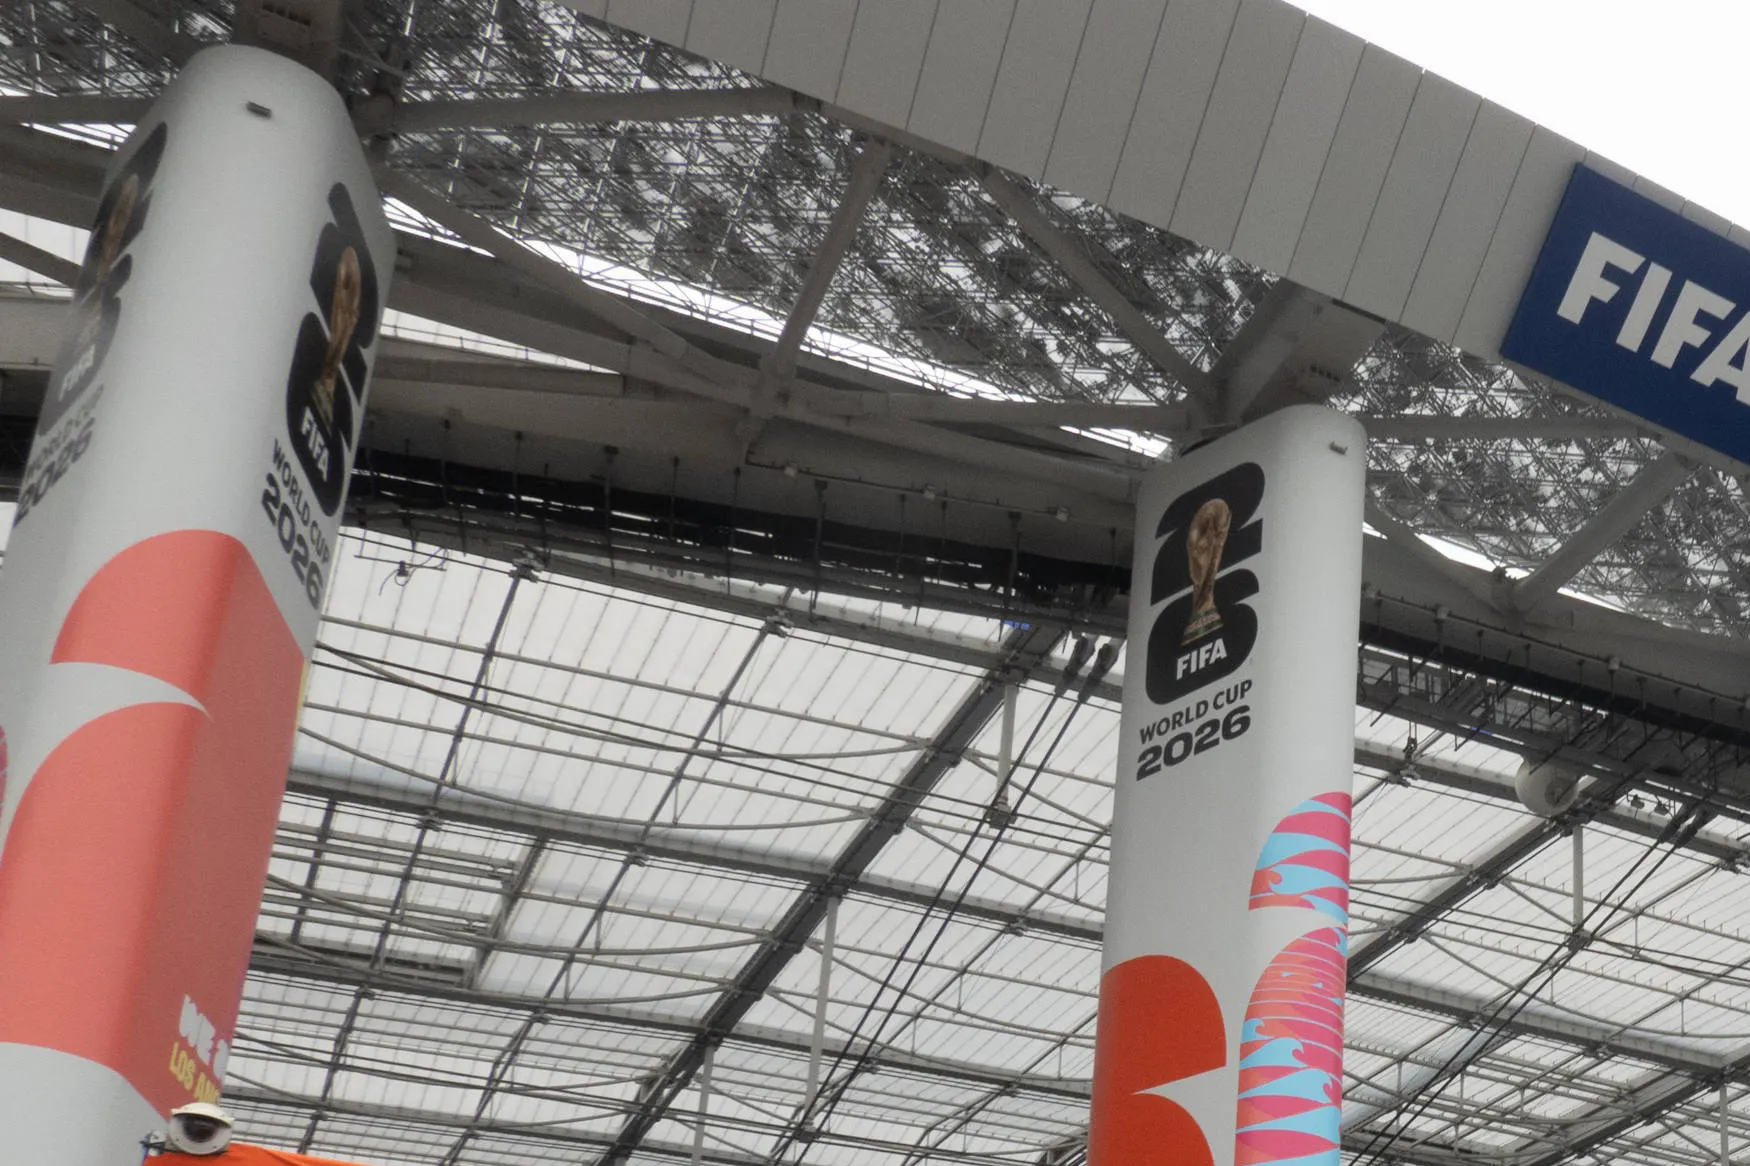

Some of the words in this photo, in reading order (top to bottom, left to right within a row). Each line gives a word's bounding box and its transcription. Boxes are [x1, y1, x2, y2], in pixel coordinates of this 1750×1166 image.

[301, 406, 330, 482] FIFA
[273, 437, 310, 527] WORLD
[310, 519, 330, 565] CUP
[261, 473, 324, 610] 2026
[1176, 638, 1227, 681] FIFA
[1135, 704, 1251, 781] 2026
[1139, 699, 1208, 745] WORLD
[1212, 679, 1253, 713] CUP
[169, 1041, 196, 1091] LOS
